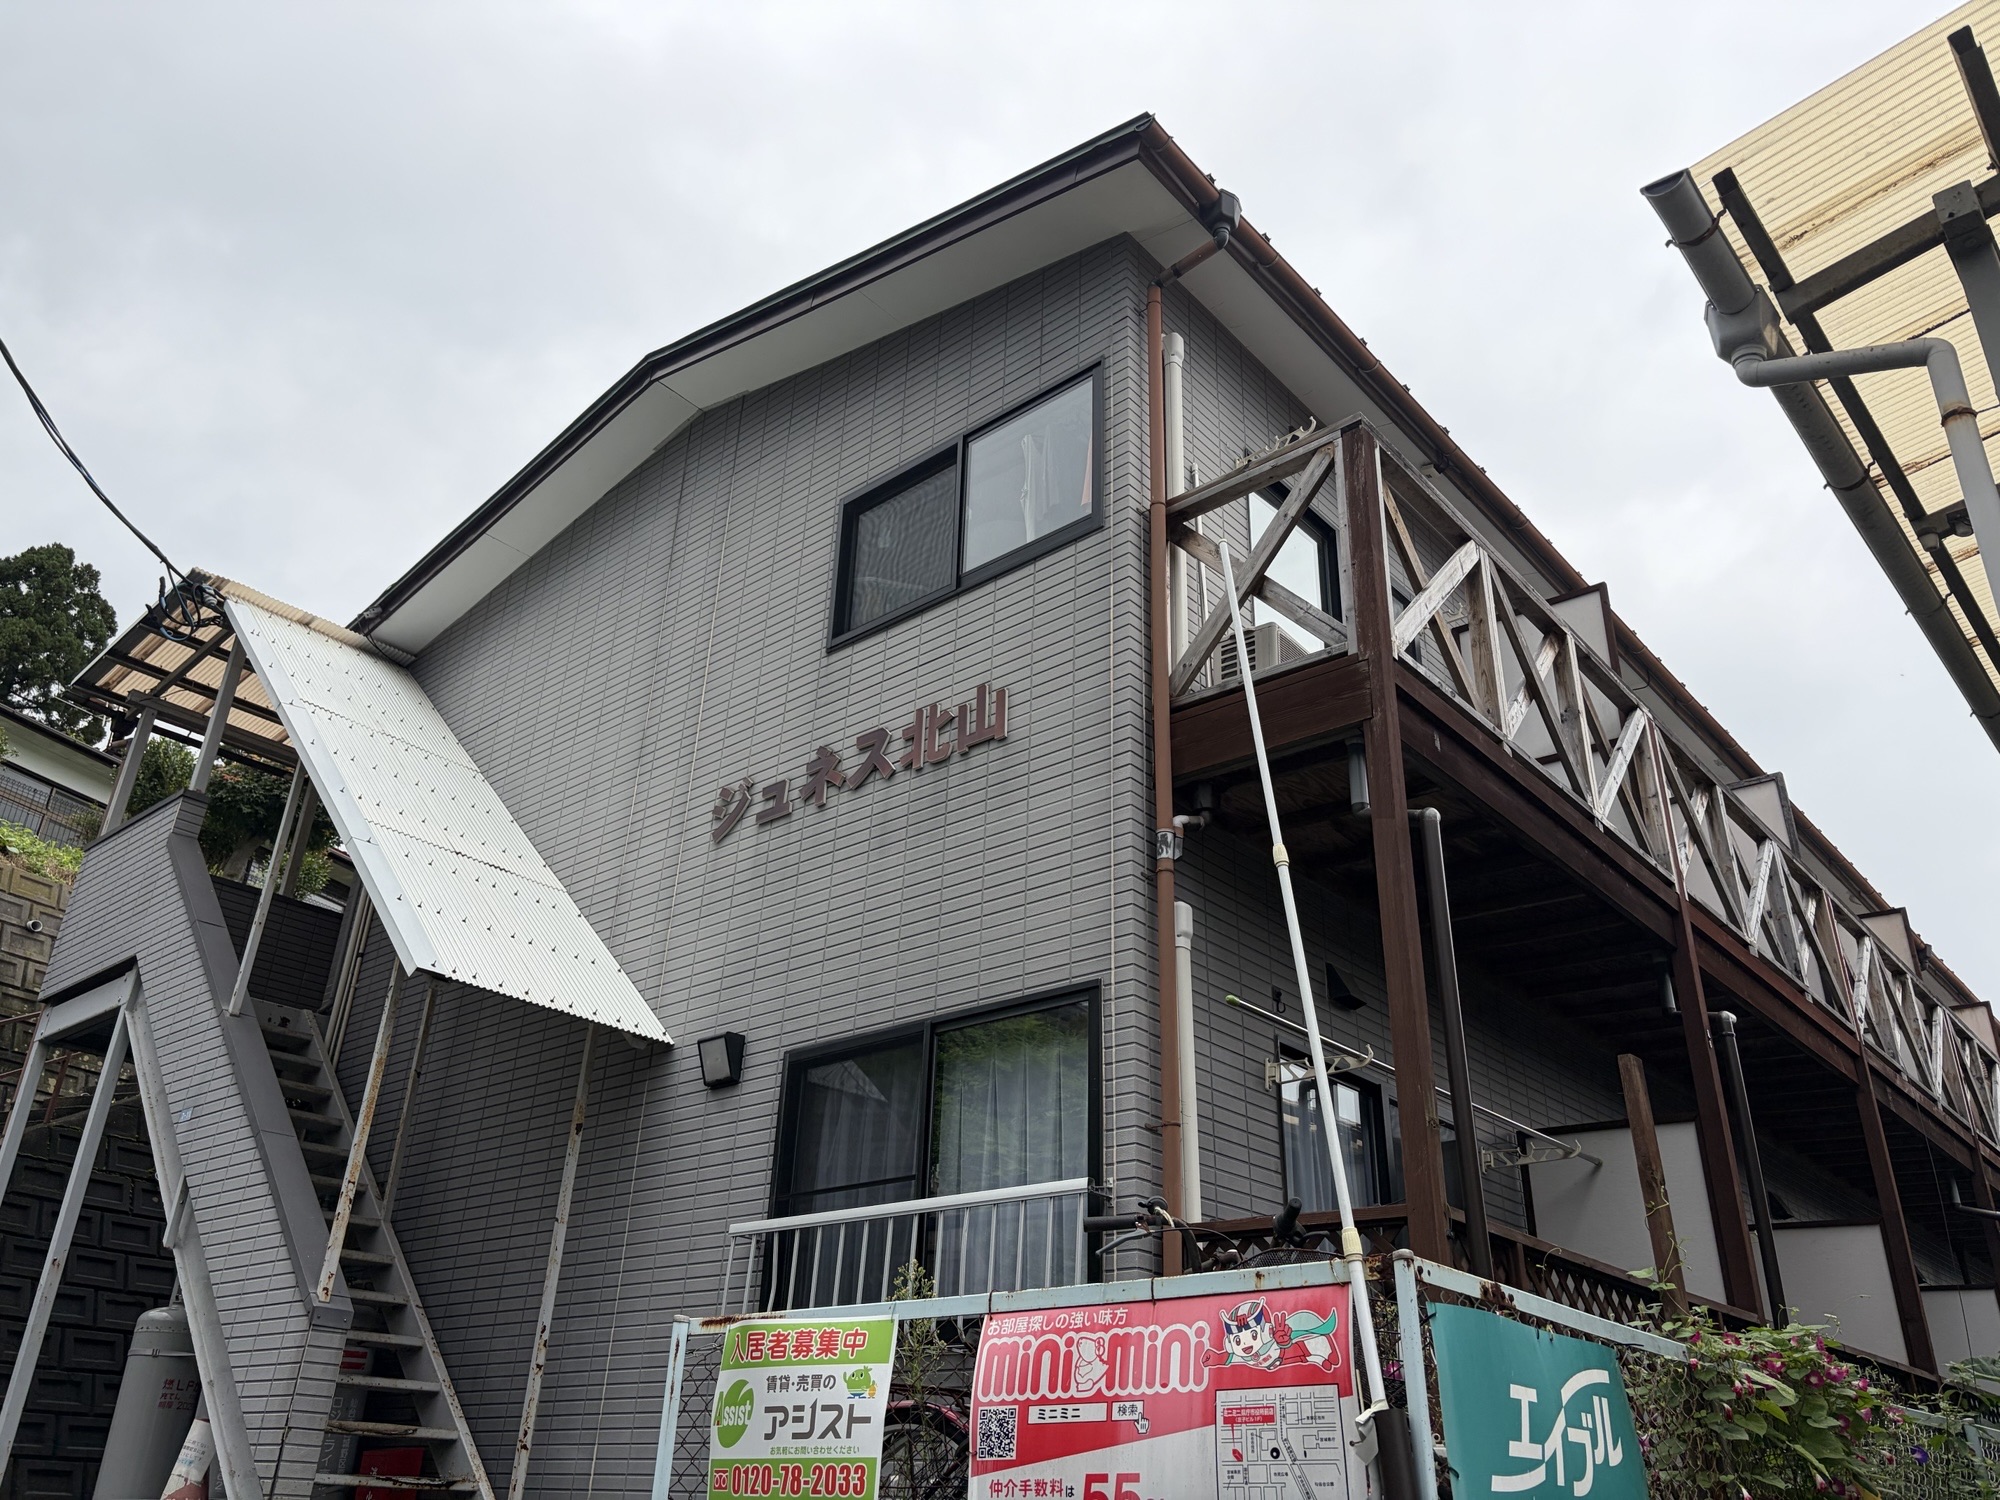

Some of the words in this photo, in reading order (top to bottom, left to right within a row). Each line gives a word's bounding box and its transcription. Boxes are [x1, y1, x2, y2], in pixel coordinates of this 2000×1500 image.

[711, 683, 1008, 844] ジュネス北山
[988, 1307, 1128, 1336] お部屋探しの強い味方
[730, 1327, 868, 1365] 入居者募集中
[766, 1374, 837, 1394] 賃貸・売買の
[763, 1398, 872, 1441] アシスト
[1037, 1407, 1081, 1420] ミニミニ
[1117, 1404, 1138, 1417] 検索
[1491, 1369, 1623, 1497] エイブル
[770, 1445, 860, 1456] お気軽にお問い合わせください
[731, 1463, 867, 1497] 0120-78-2033
[989, 1478, 1075, 1499] 仲介手数料は
